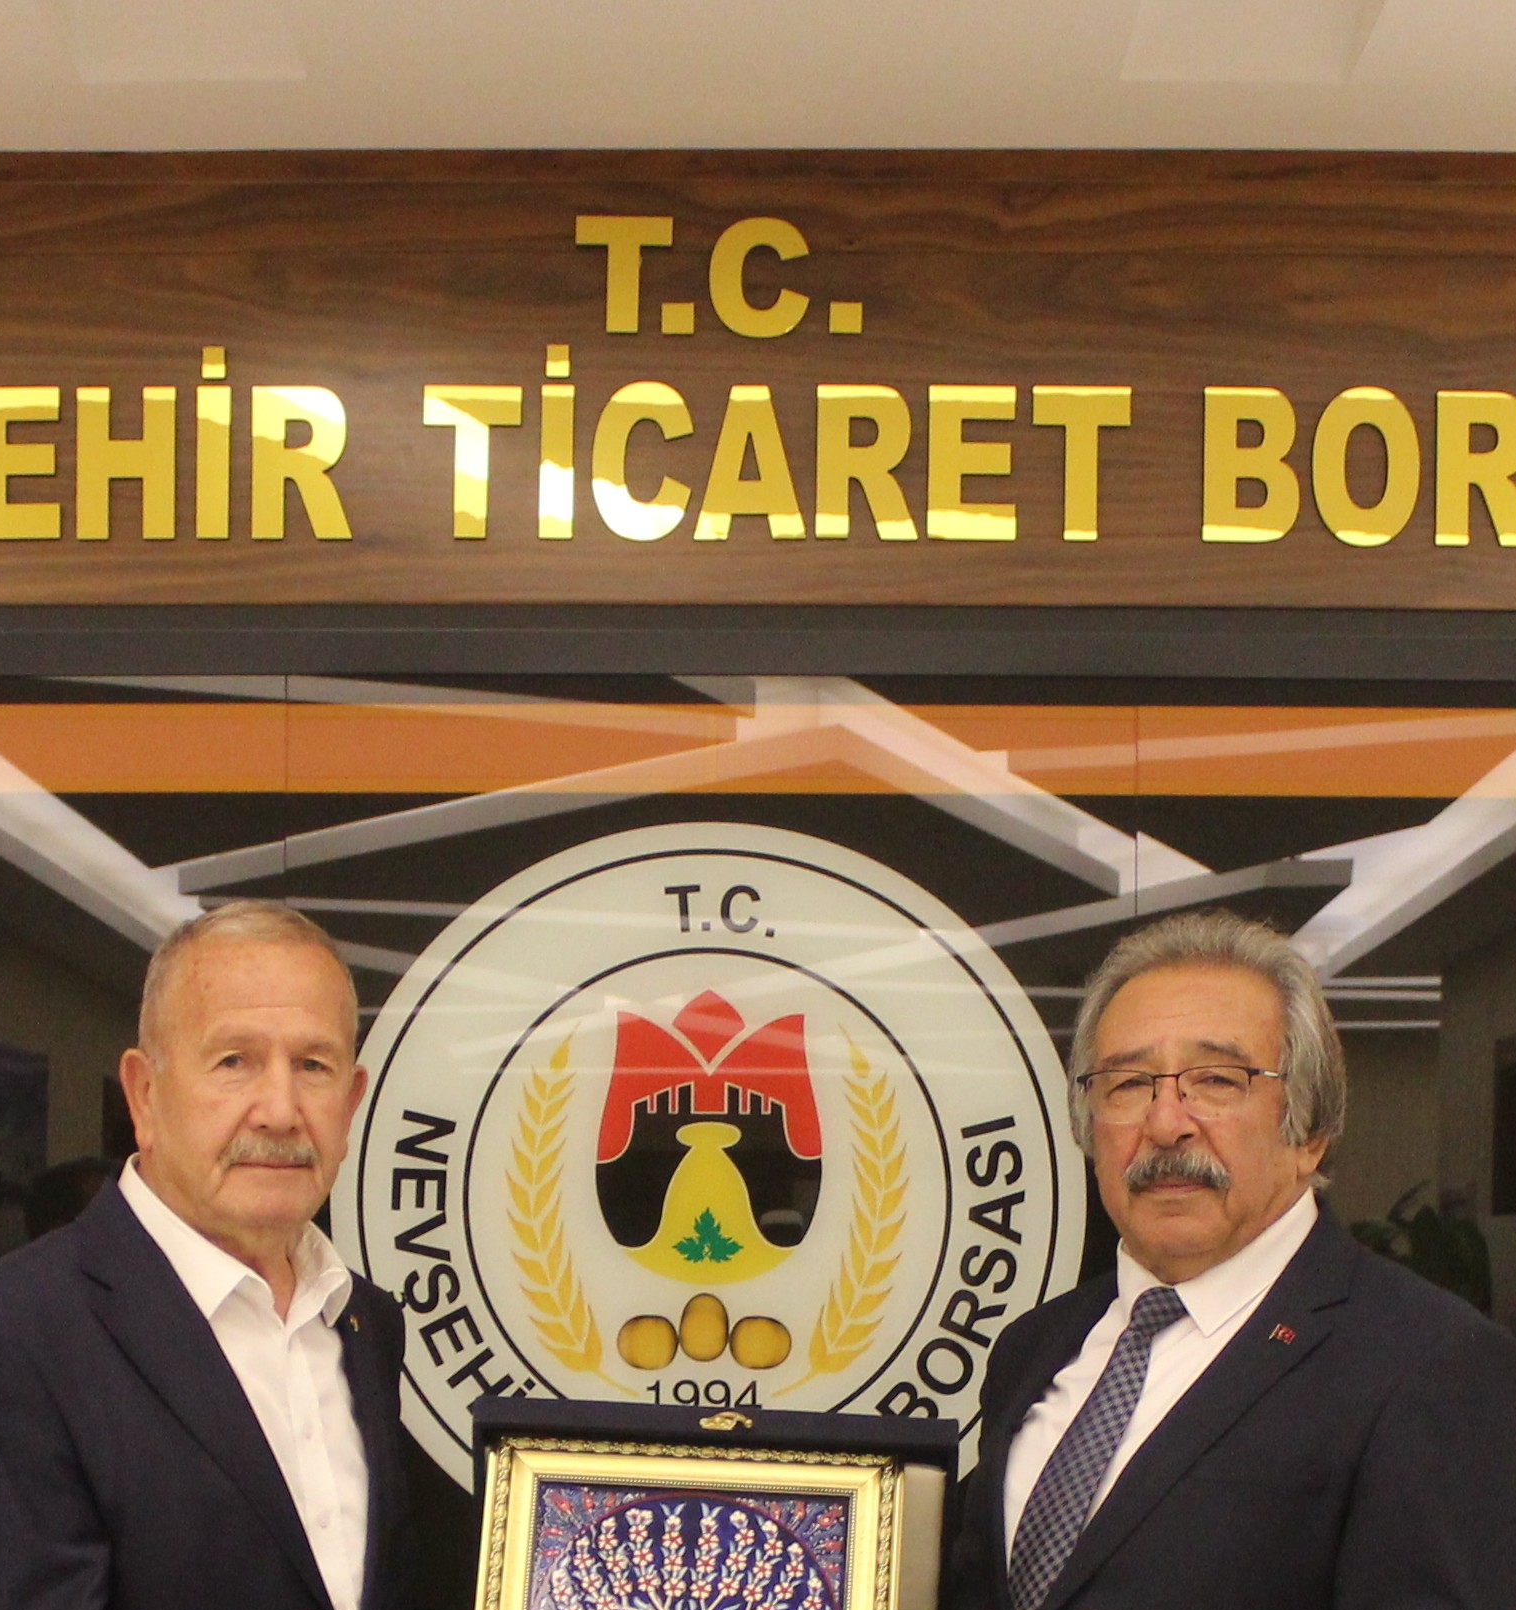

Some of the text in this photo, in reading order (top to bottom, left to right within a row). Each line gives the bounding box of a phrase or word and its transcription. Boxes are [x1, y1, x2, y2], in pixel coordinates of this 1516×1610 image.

[576, 215, 863, 339] T.C.
[422, 343, 1132, 541] TİCARET
[664, 884, 775, 938] T.C.
[876, 1115, 1025, 1419] BORSASI
[646, 1379, 762, 1408] 1994
